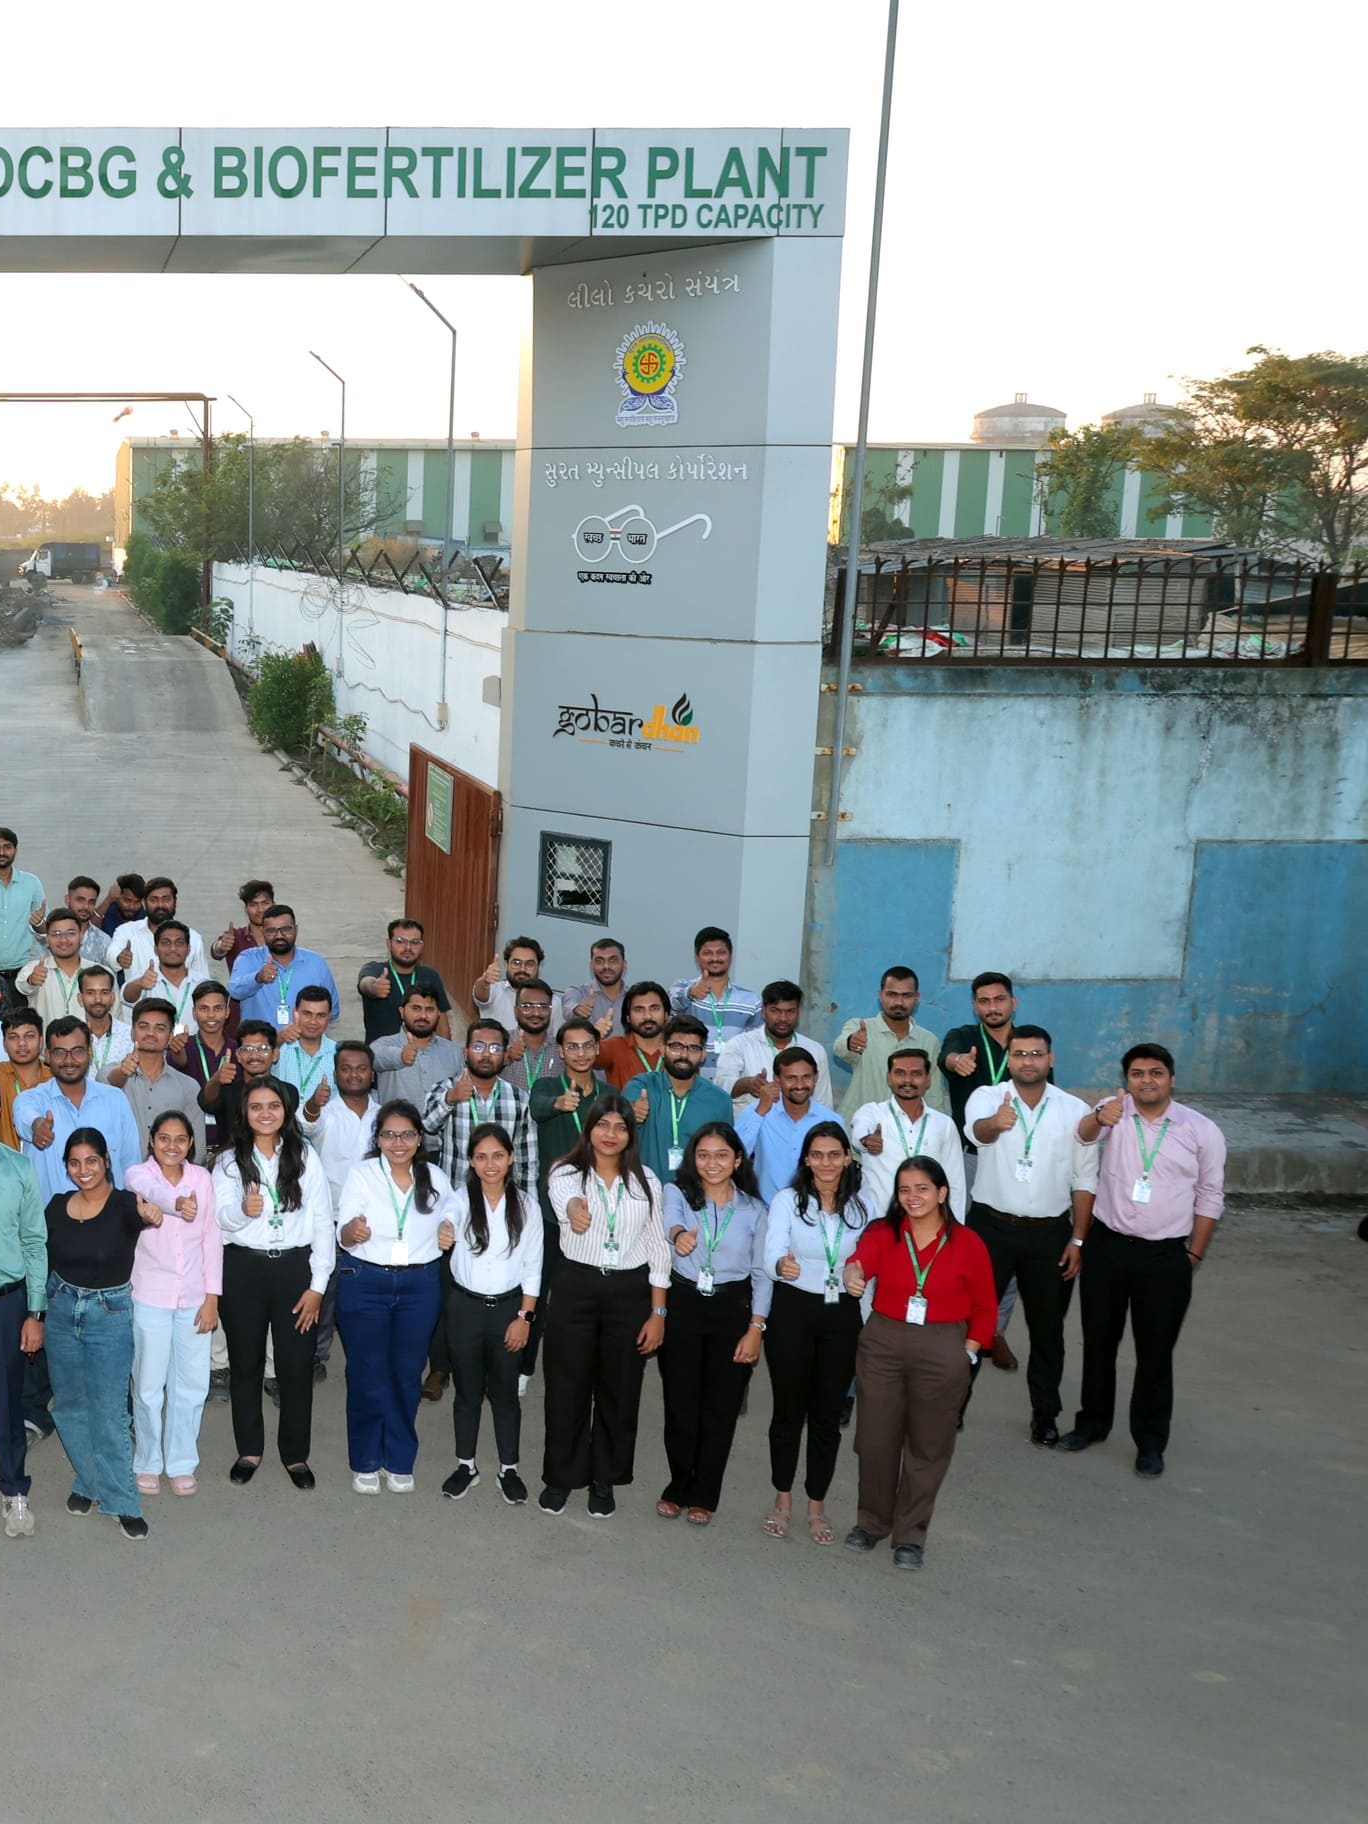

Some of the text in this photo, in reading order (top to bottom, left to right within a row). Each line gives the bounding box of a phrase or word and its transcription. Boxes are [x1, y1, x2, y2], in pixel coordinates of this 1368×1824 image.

[156, 146, 194, 199] &
[212, 146, 628, 199] BIOFERTILIZER
[646, 146, 828, 199] PLANT
[589, 203, 825, 229] 120 TPD CAPACITY
[567, 279, 615, 309] લીલો
[544, 462, 581, 488] સુરત
[627, 533, 648, 545] भारत
